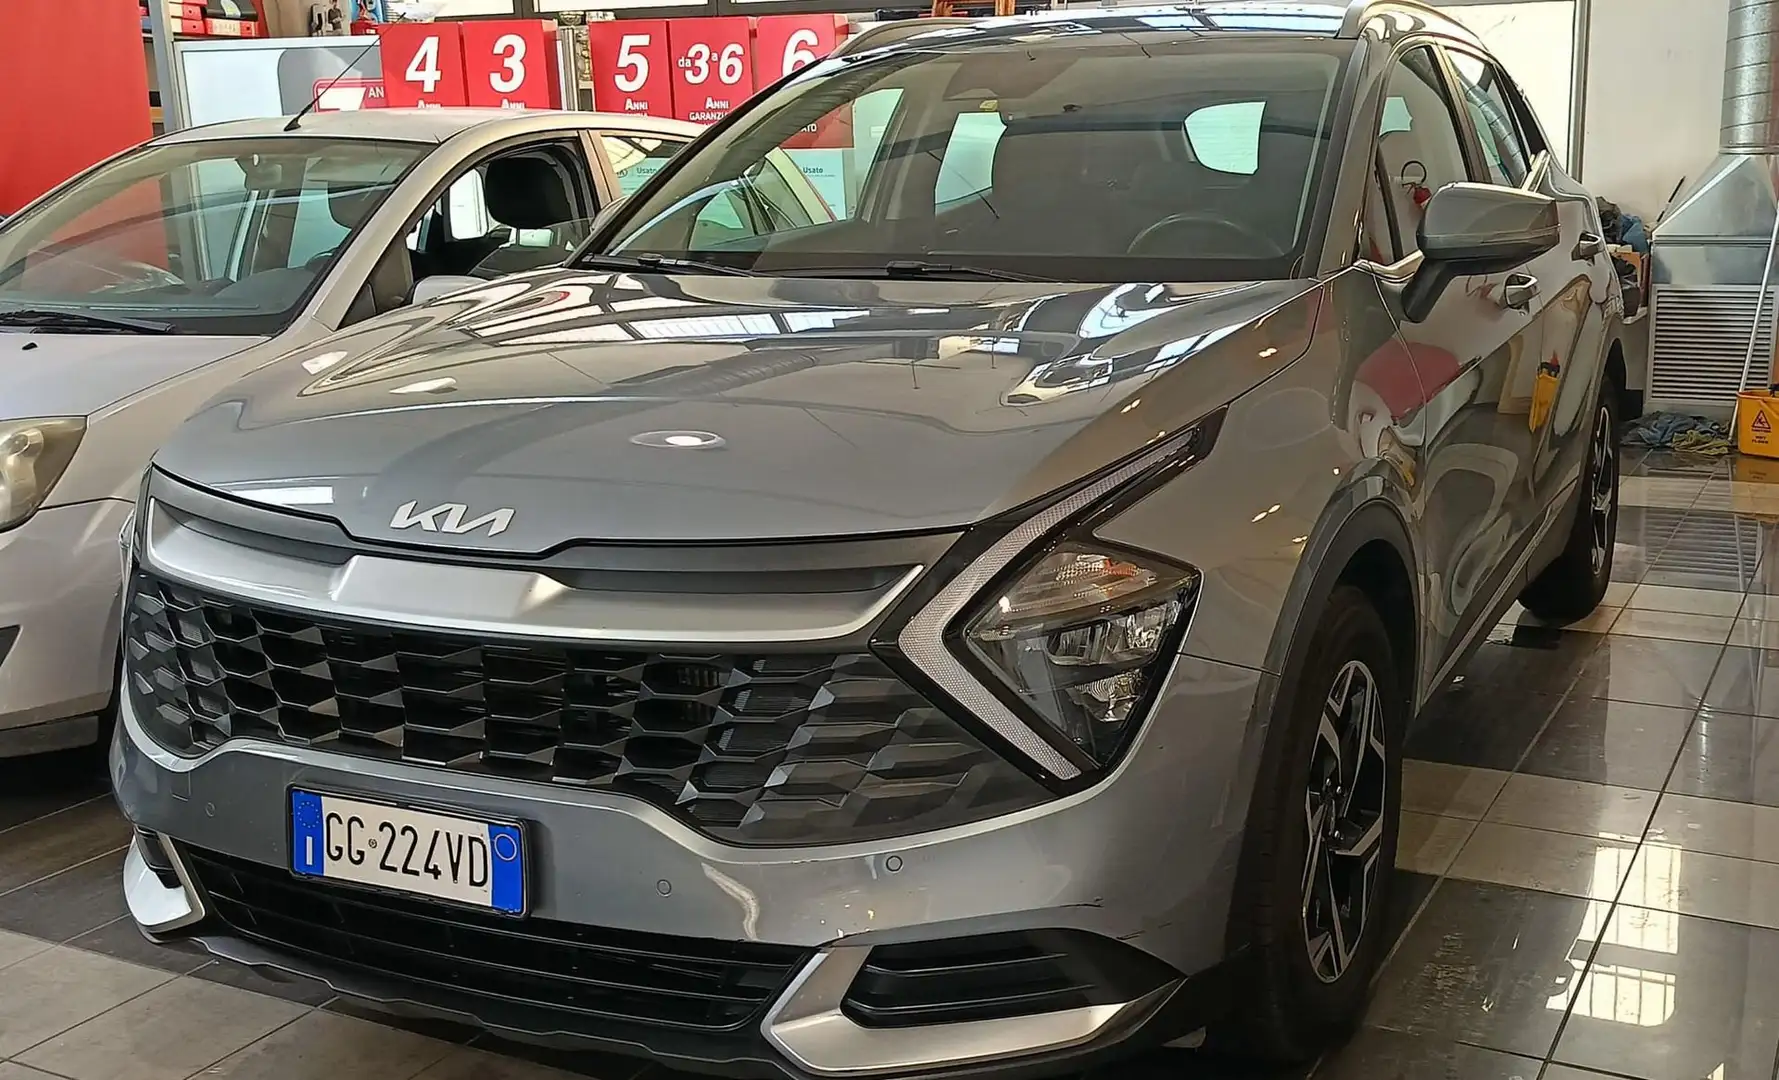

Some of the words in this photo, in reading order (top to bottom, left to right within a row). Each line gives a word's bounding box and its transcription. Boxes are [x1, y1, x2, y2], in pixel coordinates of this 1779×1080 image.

[405, 36, 442, 93] 4
[489, 34, 528, 94] 3
[613, 34, 651, 93] 5
[678, 57, 692, 67] da
[685, 43, 711, 84] 3
[719, 43, 745, 85] 6
[625, 98, 648, 110] ANNI
[705, 96, 729, 109] ANNI
[803, 166, 824, 174] Usato
[389, 499, 517, 538] KIA
